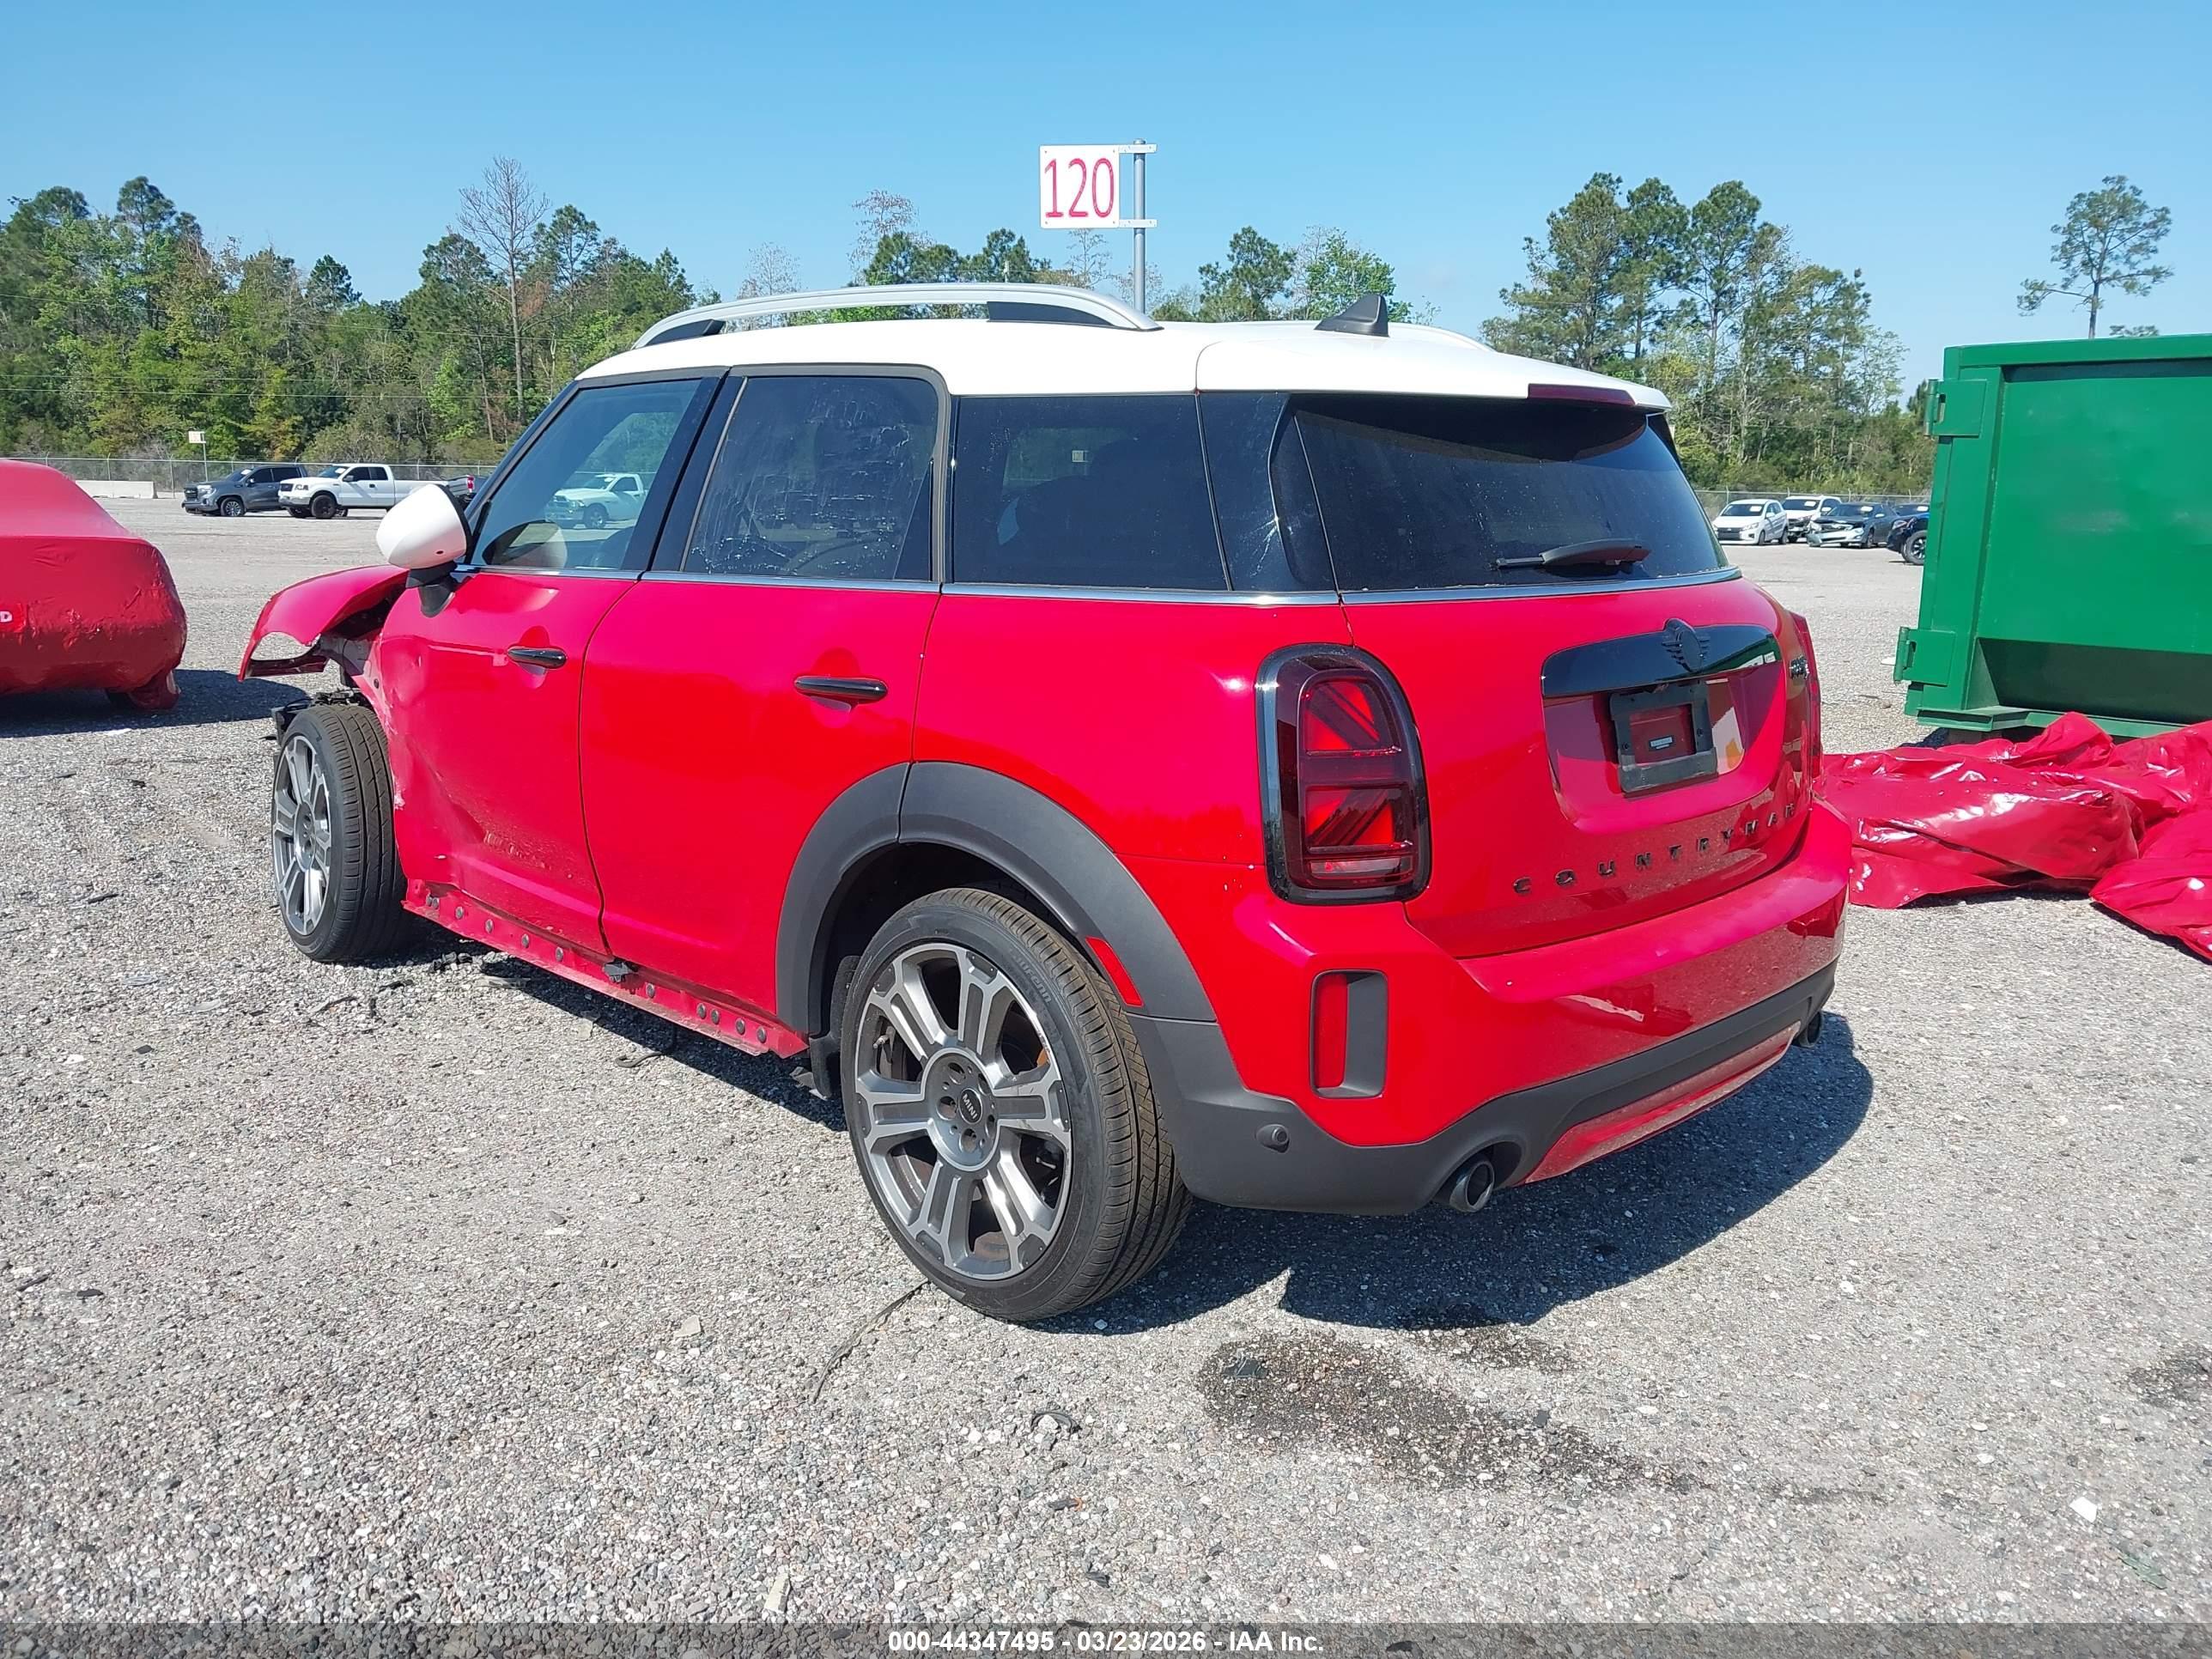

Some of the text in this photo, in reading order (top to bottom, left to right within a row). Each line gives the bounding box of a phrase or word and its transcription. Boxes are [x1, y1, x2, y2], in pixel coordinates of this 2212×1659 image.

[1044, 158, 1114, 217] 120
[1513, 802, 1796, 895] COUNTRYMAN
[962, 1093, 978, 1120] MINI
